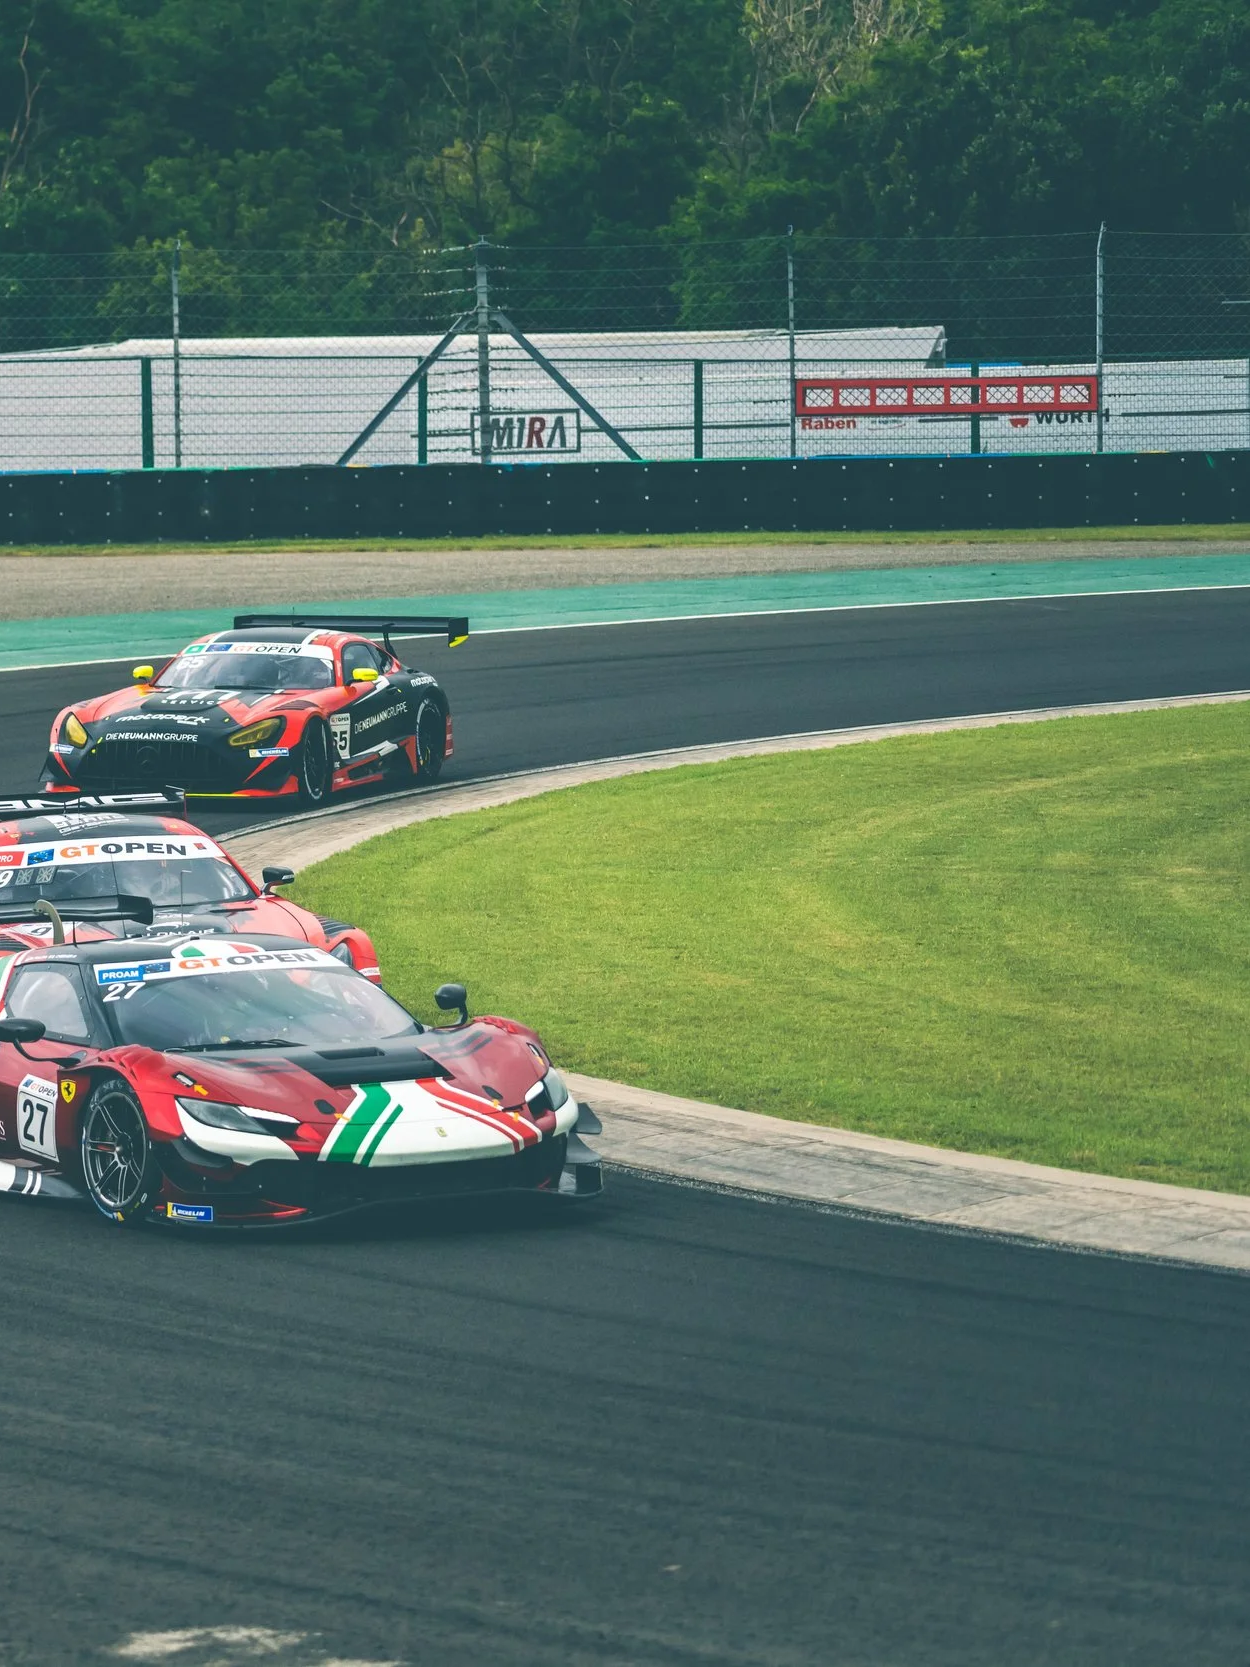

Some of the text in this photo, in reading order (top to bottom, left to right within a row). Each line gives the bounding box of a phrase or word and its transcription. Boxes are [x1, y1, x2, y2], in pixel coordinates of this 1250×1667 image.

[800, 417, 857, 430] Raben
[490, 415, 567, 449] MIRA
[177, 655, 207, 670] 65
[115, 713, 210, 725] motopark
[105, 732, 199, 743] DIENEUMANNGRUPPE
[102, 969, 140, 980] PROAM
[102, 981, 147, 1002] 27
[22, 1098, 49, 1146] 27
